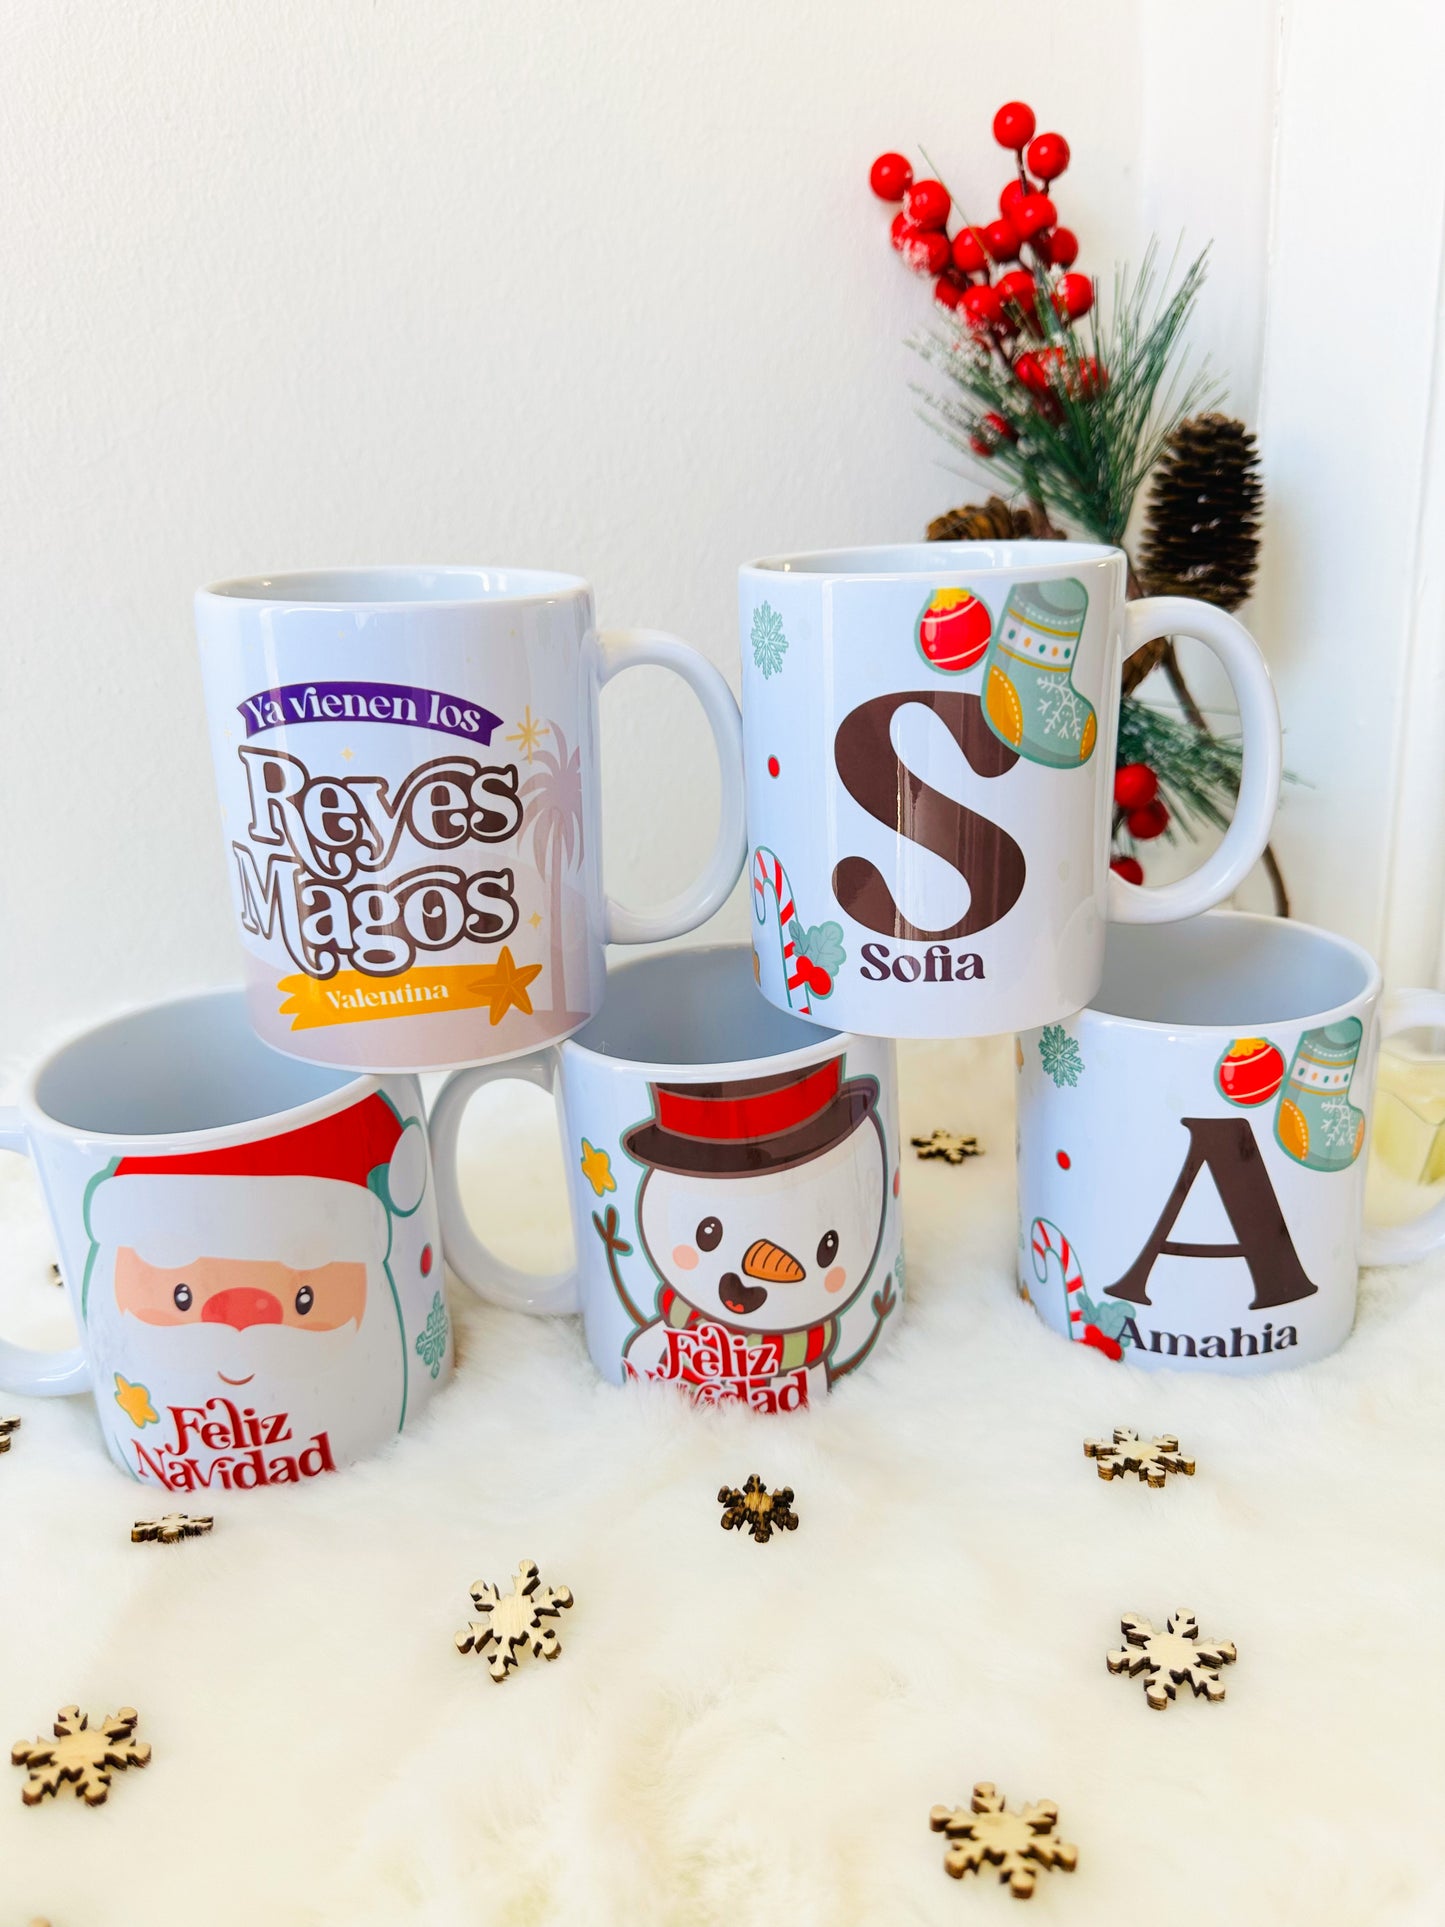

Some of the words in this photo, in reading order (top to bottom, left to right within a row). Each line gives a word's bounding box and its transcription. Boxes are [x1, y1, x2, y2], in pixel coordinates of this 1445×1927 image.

[245, 699, 287, 730] Ya
[289, 686, 418, 722] vienen
[428, 694, 482, 733] los
[238, 745, 524, 882] Reyes
[832, 690, 1027, 942] S
[232, 840, 520, 981] Magos
[860, 943, 986, 983] Sofia
[326, 981, 450, 1010] Valentina
[1102, 1117, 1319, 1310] A
[656, 1325, 778, 1379] Feliz
[1115, 1315, 1299, 1358] Amahia
[166, 1397, 293, 1456] Feliz
[131, 1431, 337, 1493] Navidad
